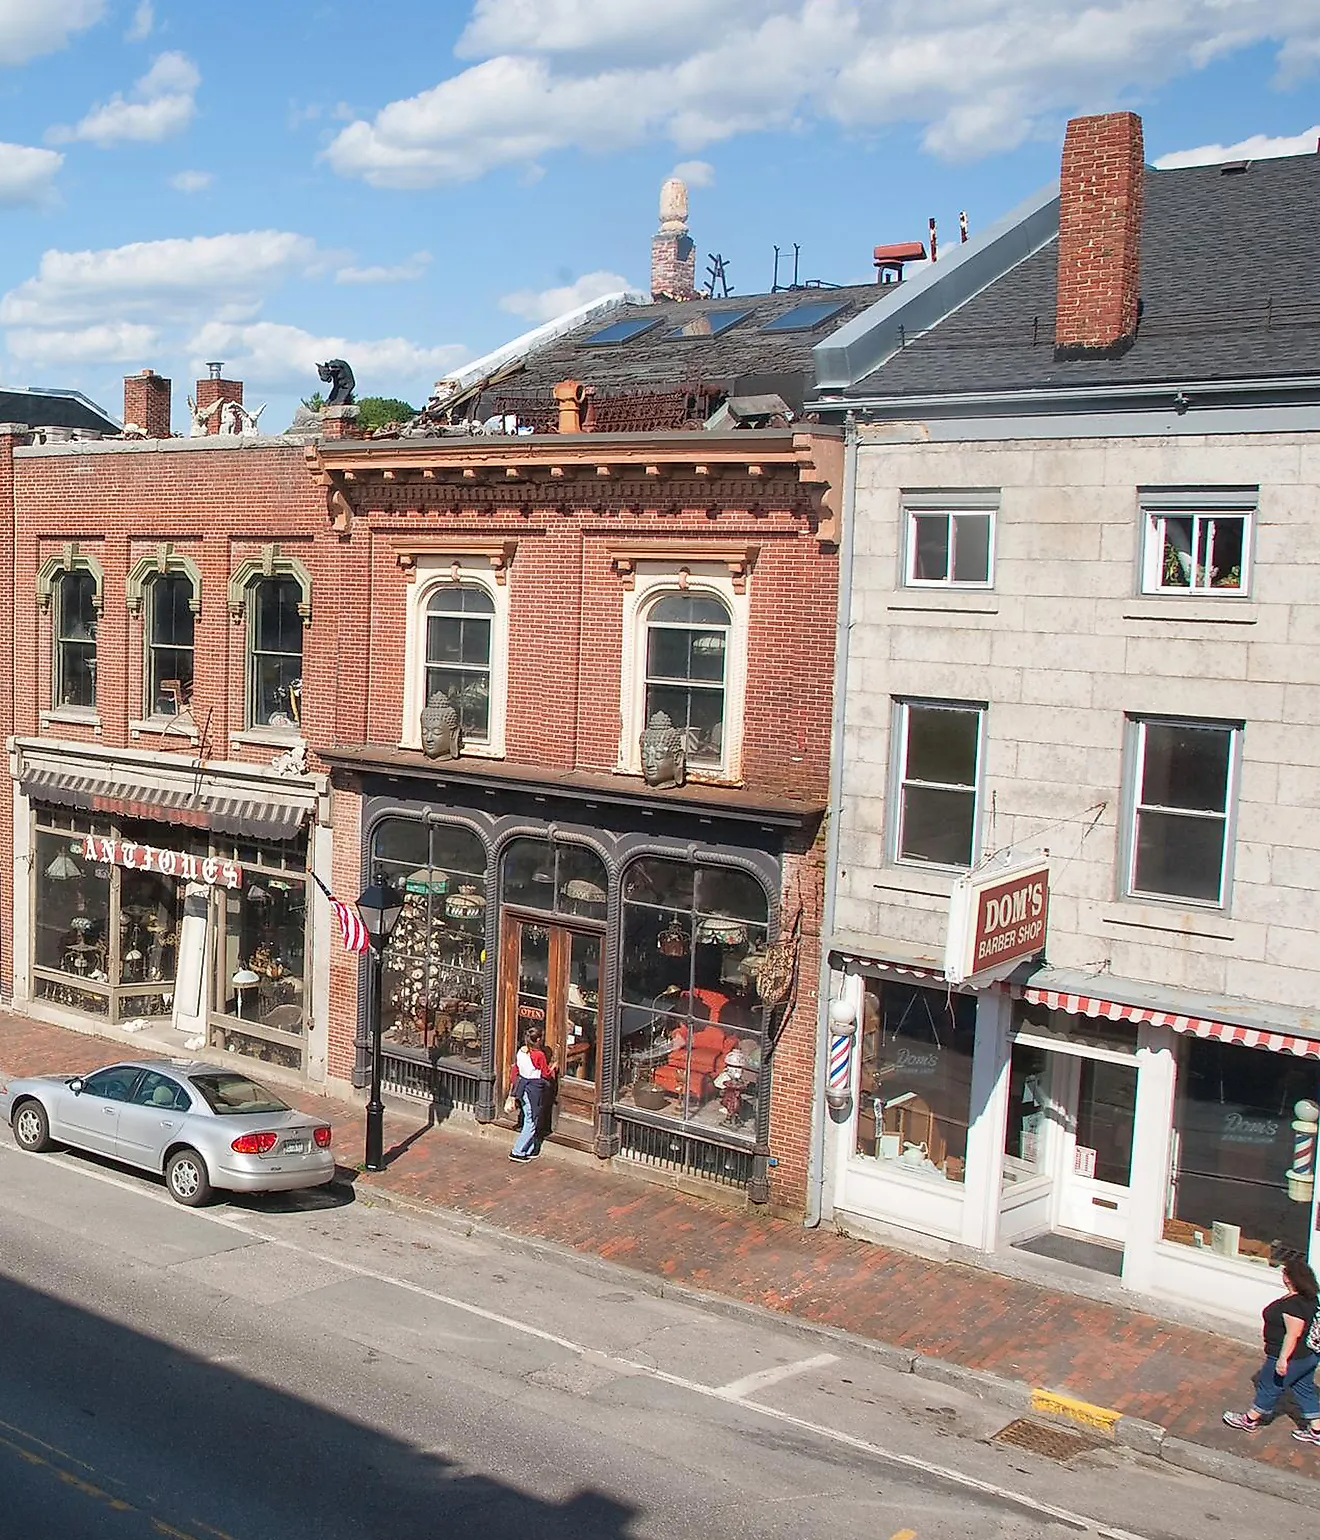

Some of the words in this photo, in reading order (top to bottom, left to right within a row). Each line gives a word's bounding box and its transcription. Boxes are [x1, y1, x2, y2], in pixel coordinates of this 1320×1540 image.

[84, 834, 239, 889] ANTIQUES
[984, 882, 1043, 934] DOM'S
[978, 929, 1016, 960] BARBER
[1017, 920, 1043, 944] SHOP
[520, 1008, 541, 1018] OPEN
[896, 1047, 939, 1068] Dom's
[1223, 1112, 1279, 1136] Dom's
